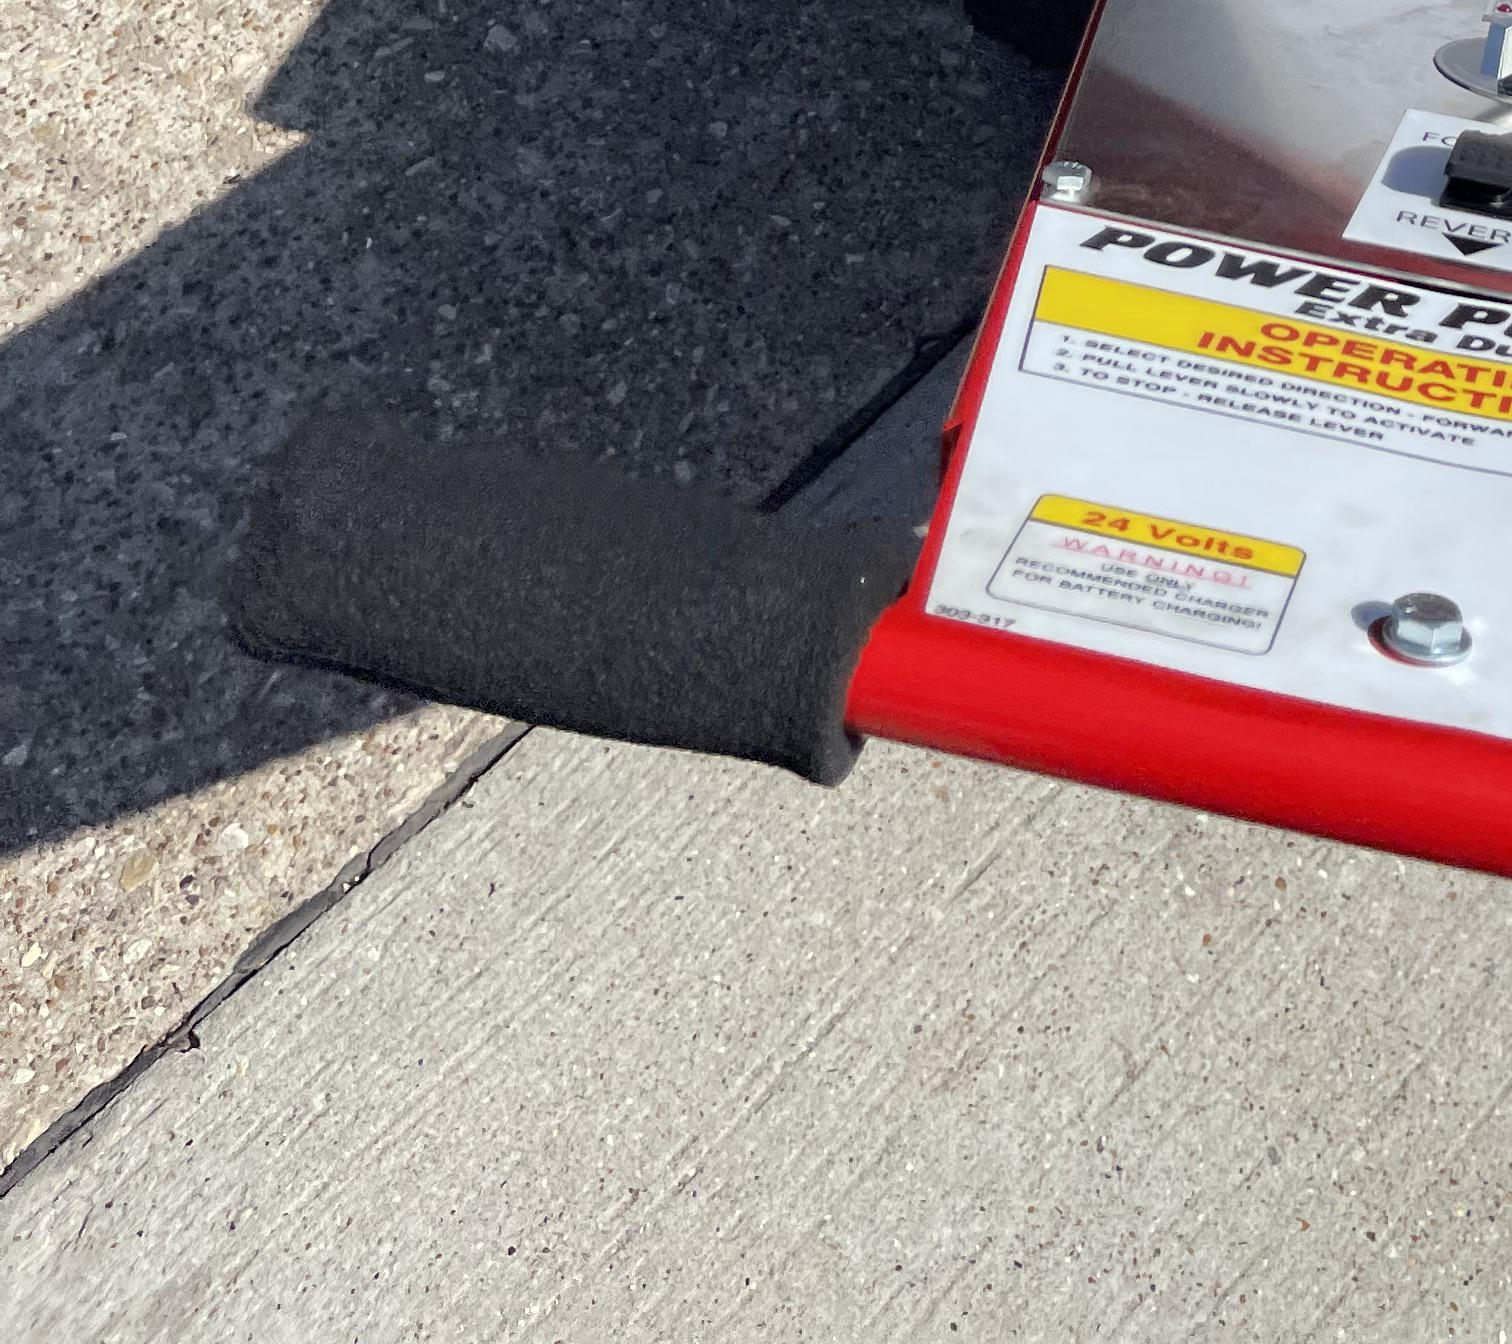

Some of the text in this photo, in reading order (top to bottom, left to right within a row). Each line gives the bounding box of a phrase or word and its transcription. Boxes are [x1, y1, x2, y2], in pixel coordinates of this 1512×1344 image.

[1079, 226, 1421, 318] POWER
[1293, 300, 1439, 344] Extra
[1080, 367, 1110, 381] TO
[1115, 375, 1177, 395] STOP
[1197, 393, 1303, 422] RELEASE
[1309, 417, 1385, 441] LEVER
[1082, 353, 1138, 373] PULL
[1145, 367, 1219, 390] LEVER
[1225, 383, 1319, 411] SLOWLY
[1328, 405, 1357, 420] TO
[1364, 415, 1476, 447] ACTIVATE
[1084, 338, 1170, 364] SELECT
[1176, 358, 1275, 386] DESIRED
[1280, 381, 1401, 415] DIRECTION
[1082, 510, 1254, 561] 24 Volts
[1011, 568, 1263, 633] FOR BATTERY CHARGING!
[1014, 555, 1271, 619] RECOMMENDED CHARGER
[1100, 562, 1197, 592] USE ONLY
